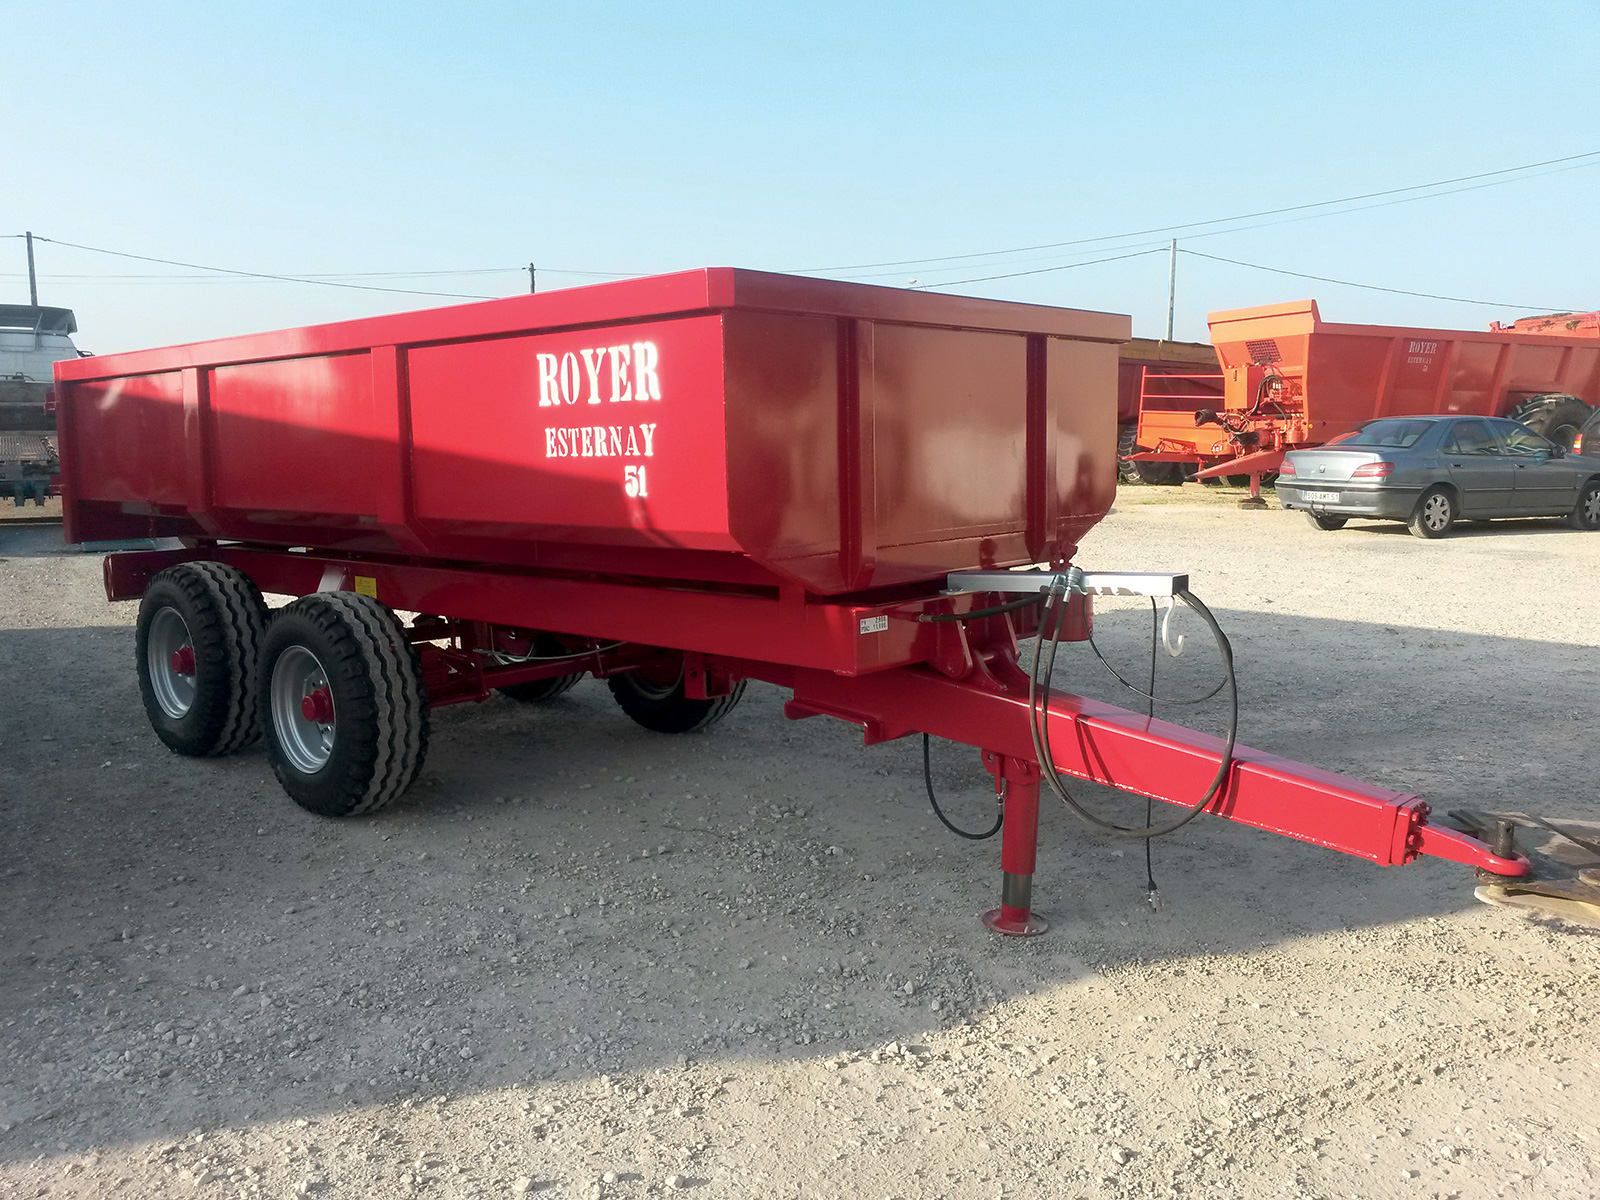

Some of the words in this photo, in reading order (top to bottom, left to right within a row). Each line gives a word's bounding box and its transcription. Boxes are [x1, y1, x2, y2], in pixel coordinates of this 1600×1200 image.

[1409, 341, 1437, 354] ROYER
[536, 341, 661, 407] ROYER
[545, 423, 657, 458] ESTERNAY
[624, 465, 648, 498] 51
